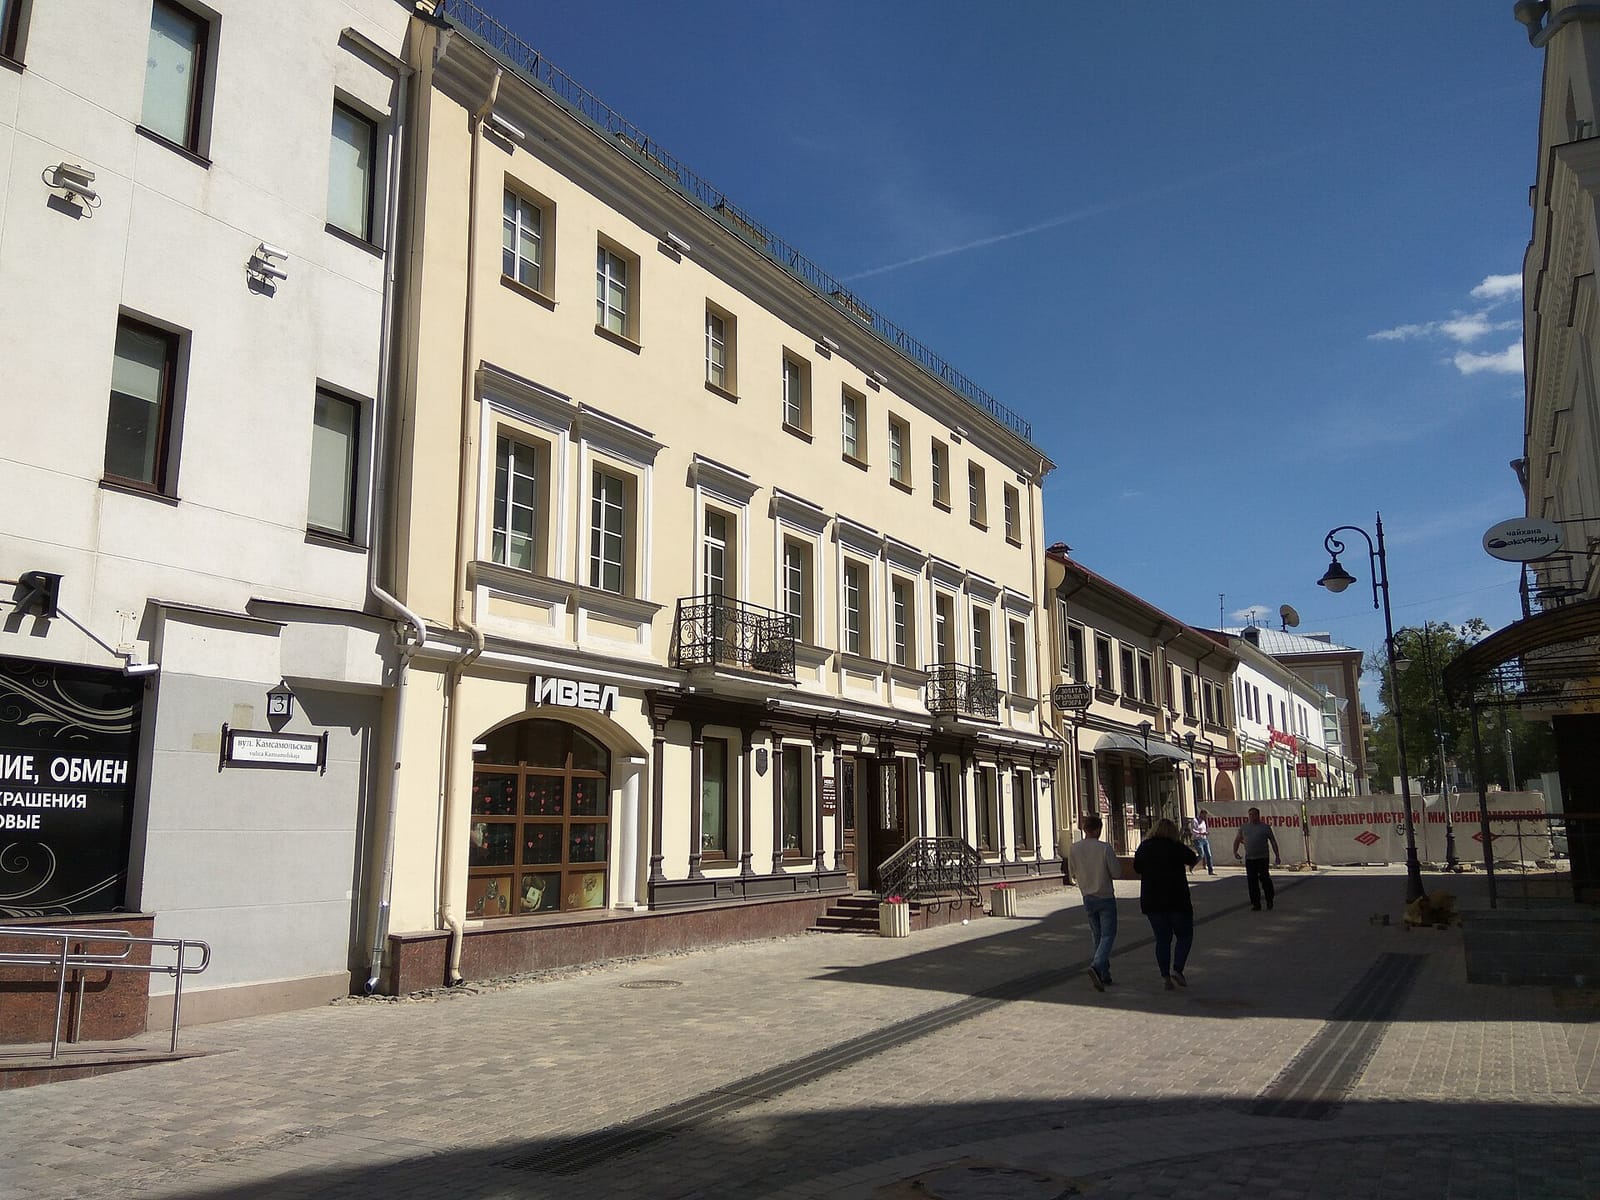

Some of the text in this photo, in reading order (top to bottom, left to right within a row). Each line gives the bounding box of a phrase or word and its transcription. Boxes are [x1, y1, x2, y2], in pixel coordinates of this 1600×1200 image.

[534, 675, 619, 711] ИВЕЛ
[273, 695, 284, 712] 3
[238, 739, 312, 750] вул. Камсамольская
[0, 754, 129, 785] ИЕ, ОБМЕН
[1310, 810, 1420, 827] МИНСКПРОМСТРЙ
